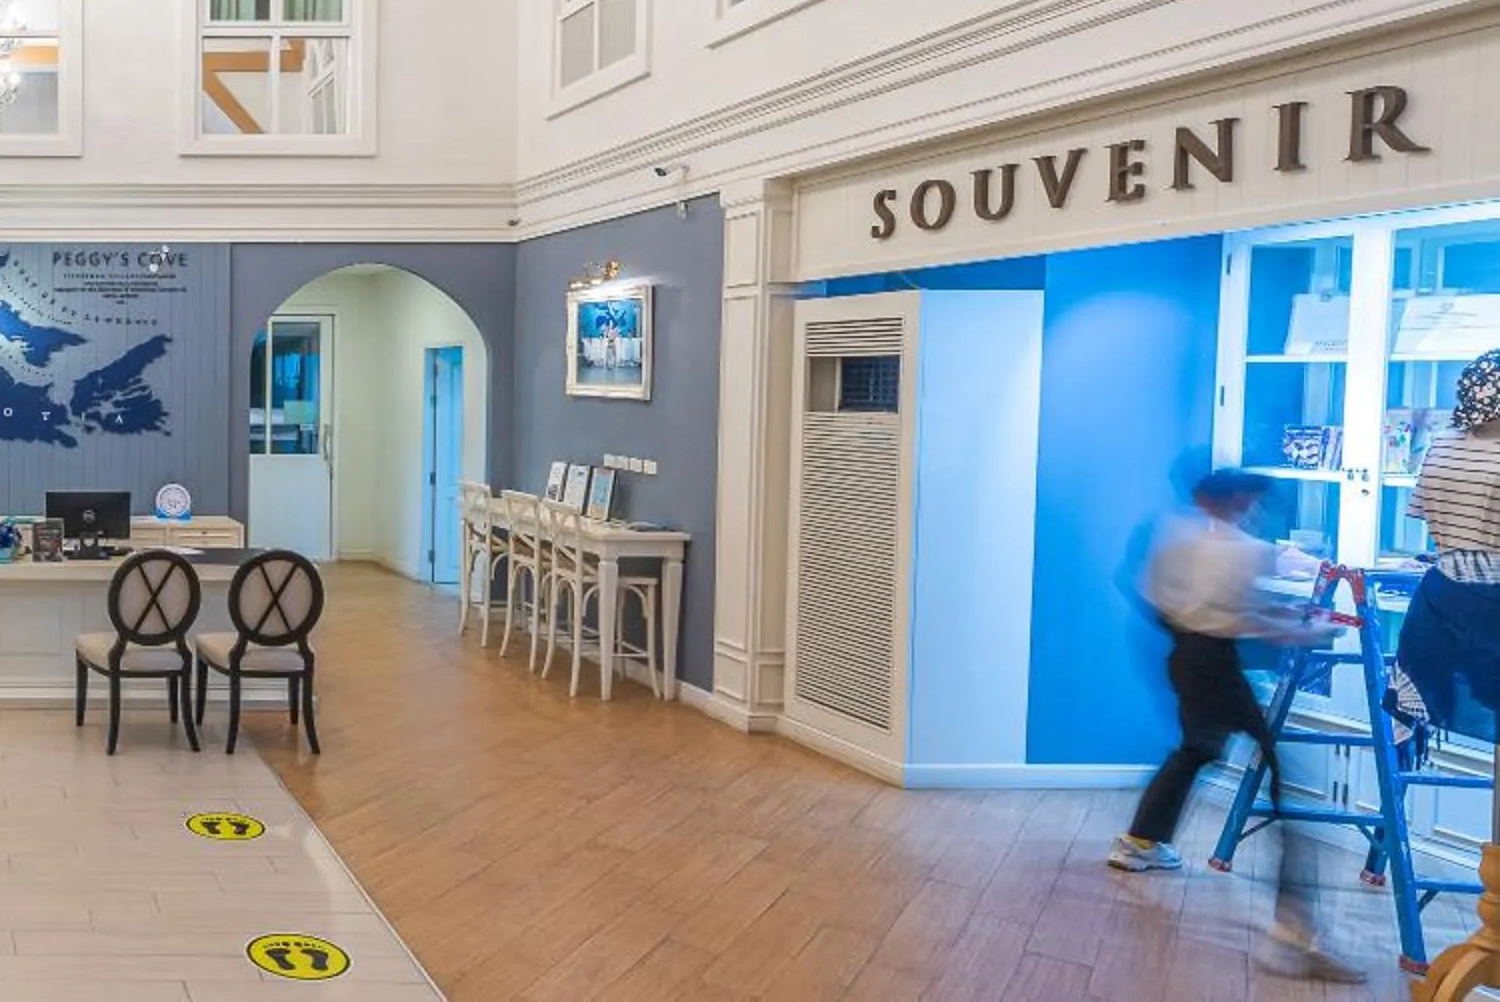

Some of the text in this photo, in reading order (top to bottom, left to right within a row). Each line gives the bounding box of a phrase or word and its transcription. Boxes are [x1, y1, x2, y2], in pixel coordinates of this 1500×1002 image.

[871, 85, 1431, 240] SOUVENIR
[52, 251, 188, 267] PEGGY'S COVE
